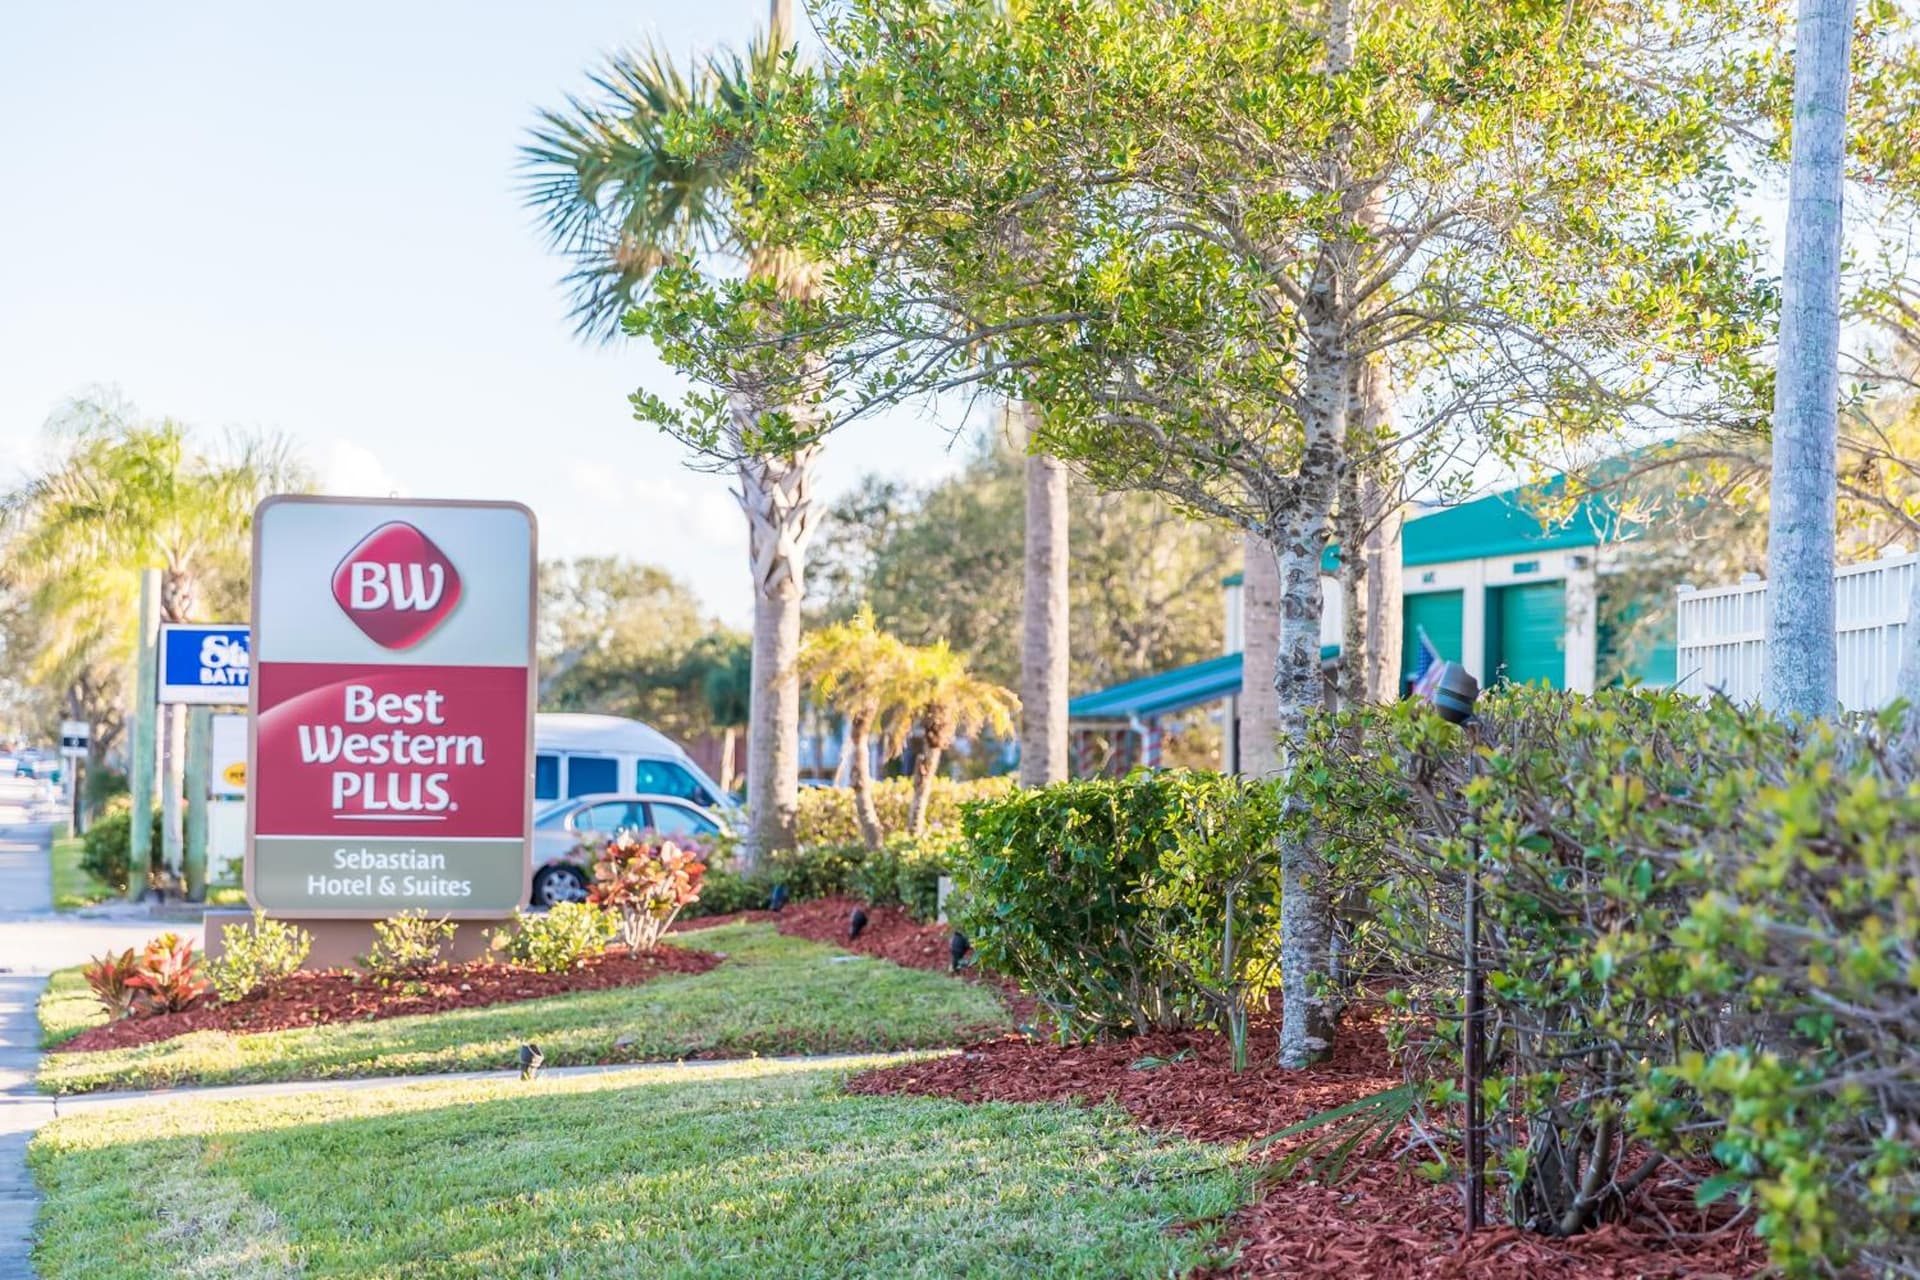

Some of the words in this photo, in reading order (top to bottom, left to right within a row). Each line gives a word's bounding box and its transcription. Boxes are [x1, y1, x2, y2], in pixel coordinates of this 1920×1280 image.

[350, 561, 445, 612] BW
[345, 684, 445, 725] Best
[298, 725, 486, 765] Western
[333, 848, 446, 870] Sebastian
[307, 875, 372, 896] Hotel
[378, 876, 397, 896] &
[402, 876, 472, 896] Suites
